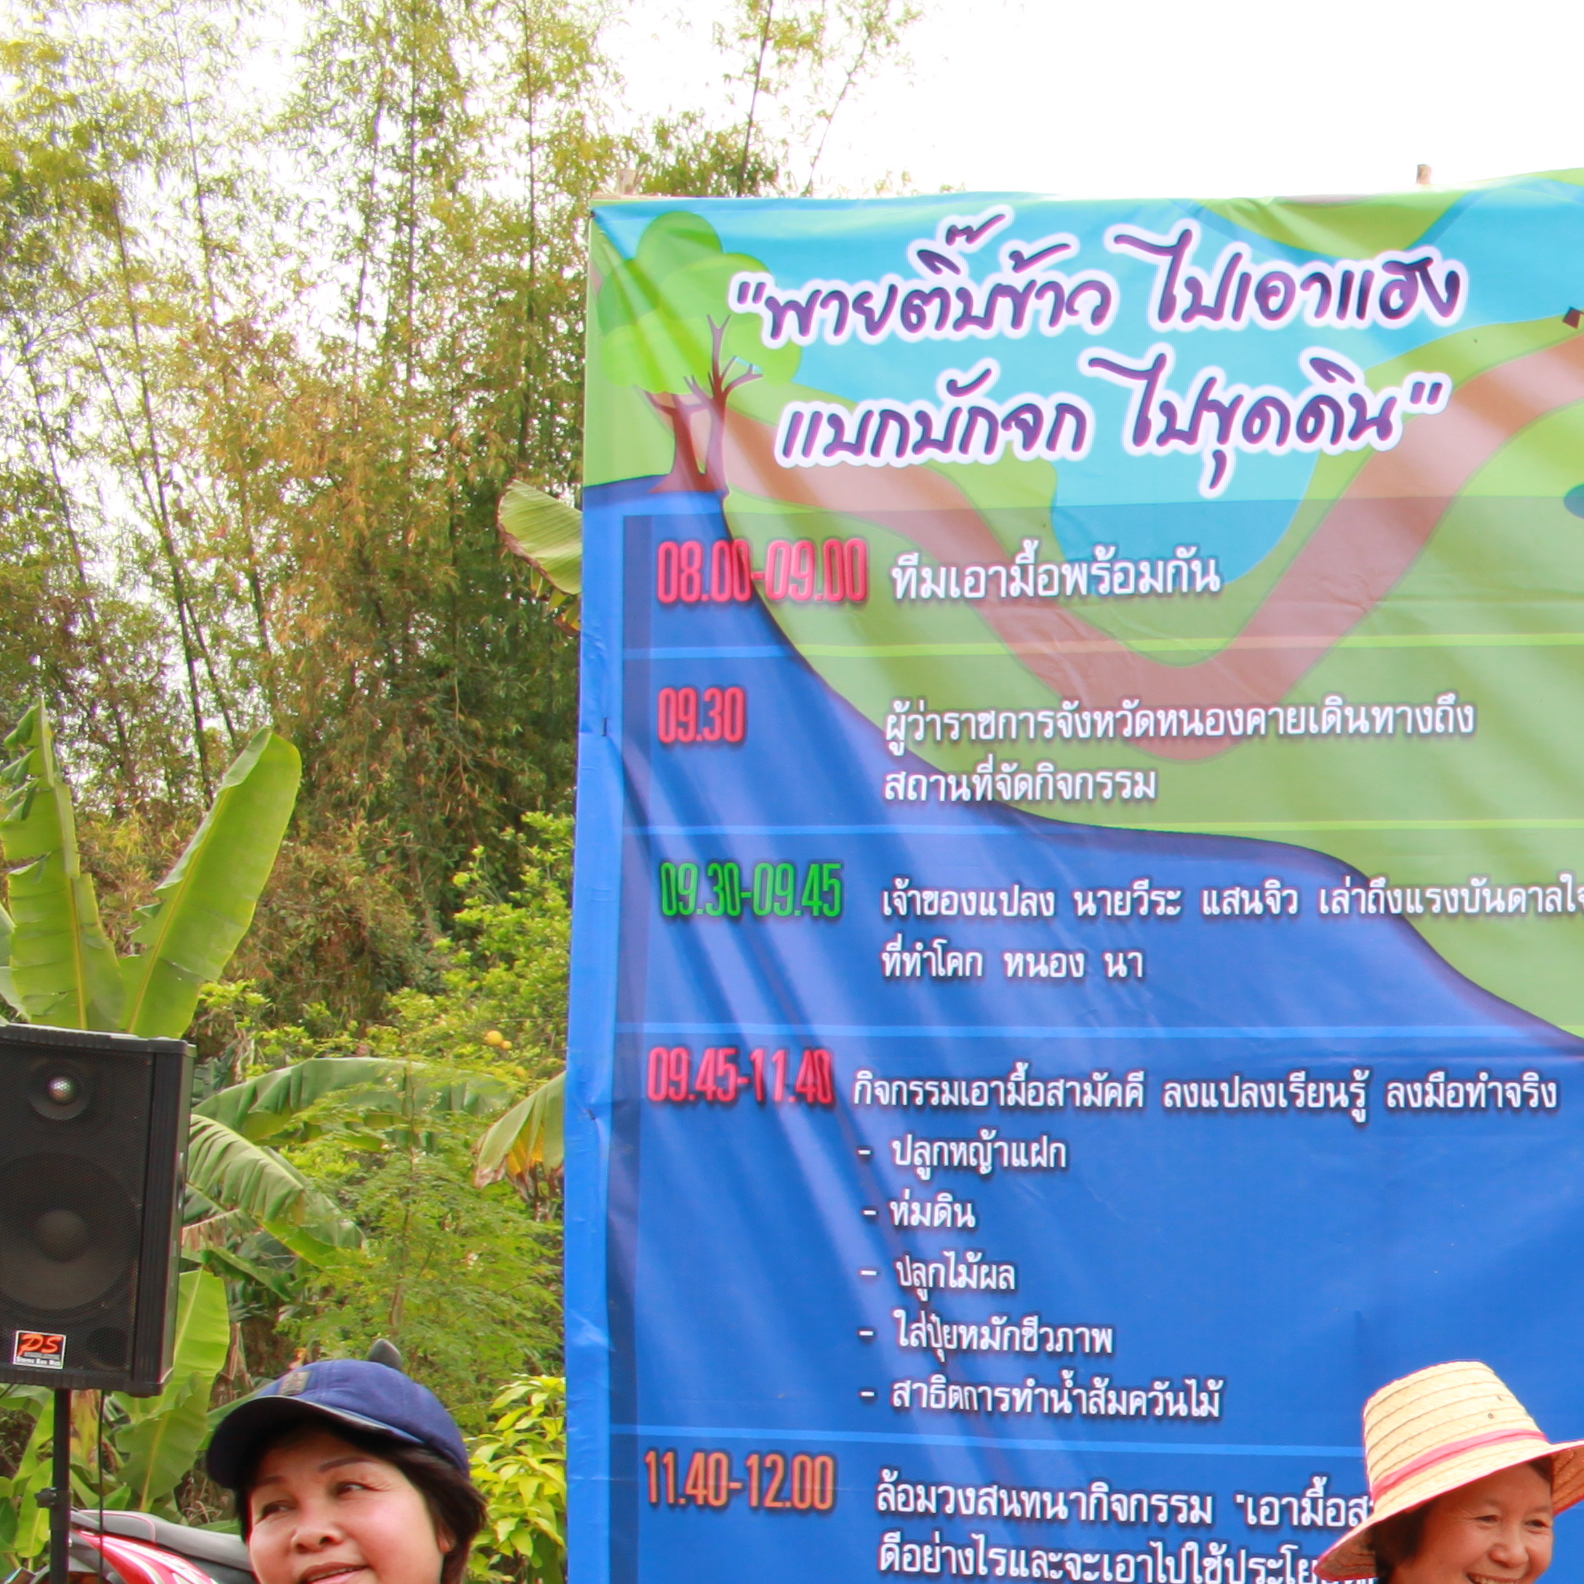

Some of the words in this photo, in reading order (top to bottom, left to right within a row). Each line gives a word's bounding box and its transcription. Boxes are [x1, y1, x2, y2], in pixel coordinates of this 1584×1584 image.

[658, 539, 869, 604] 08.00-09.00
[658, 687, 746, 744] 09.30
[661, 862, 844, 918] 09.30-09.45
[882, 877, 1056, 918] เจ้าของแปลง
[1003, 947, 1085, 980] หนอง
[1104, 949, 1144, 980] นา
[647, 1046, 834, 1104] 09.45-11.40
[645, 1450, 836, 1512] 11.40-12.00
